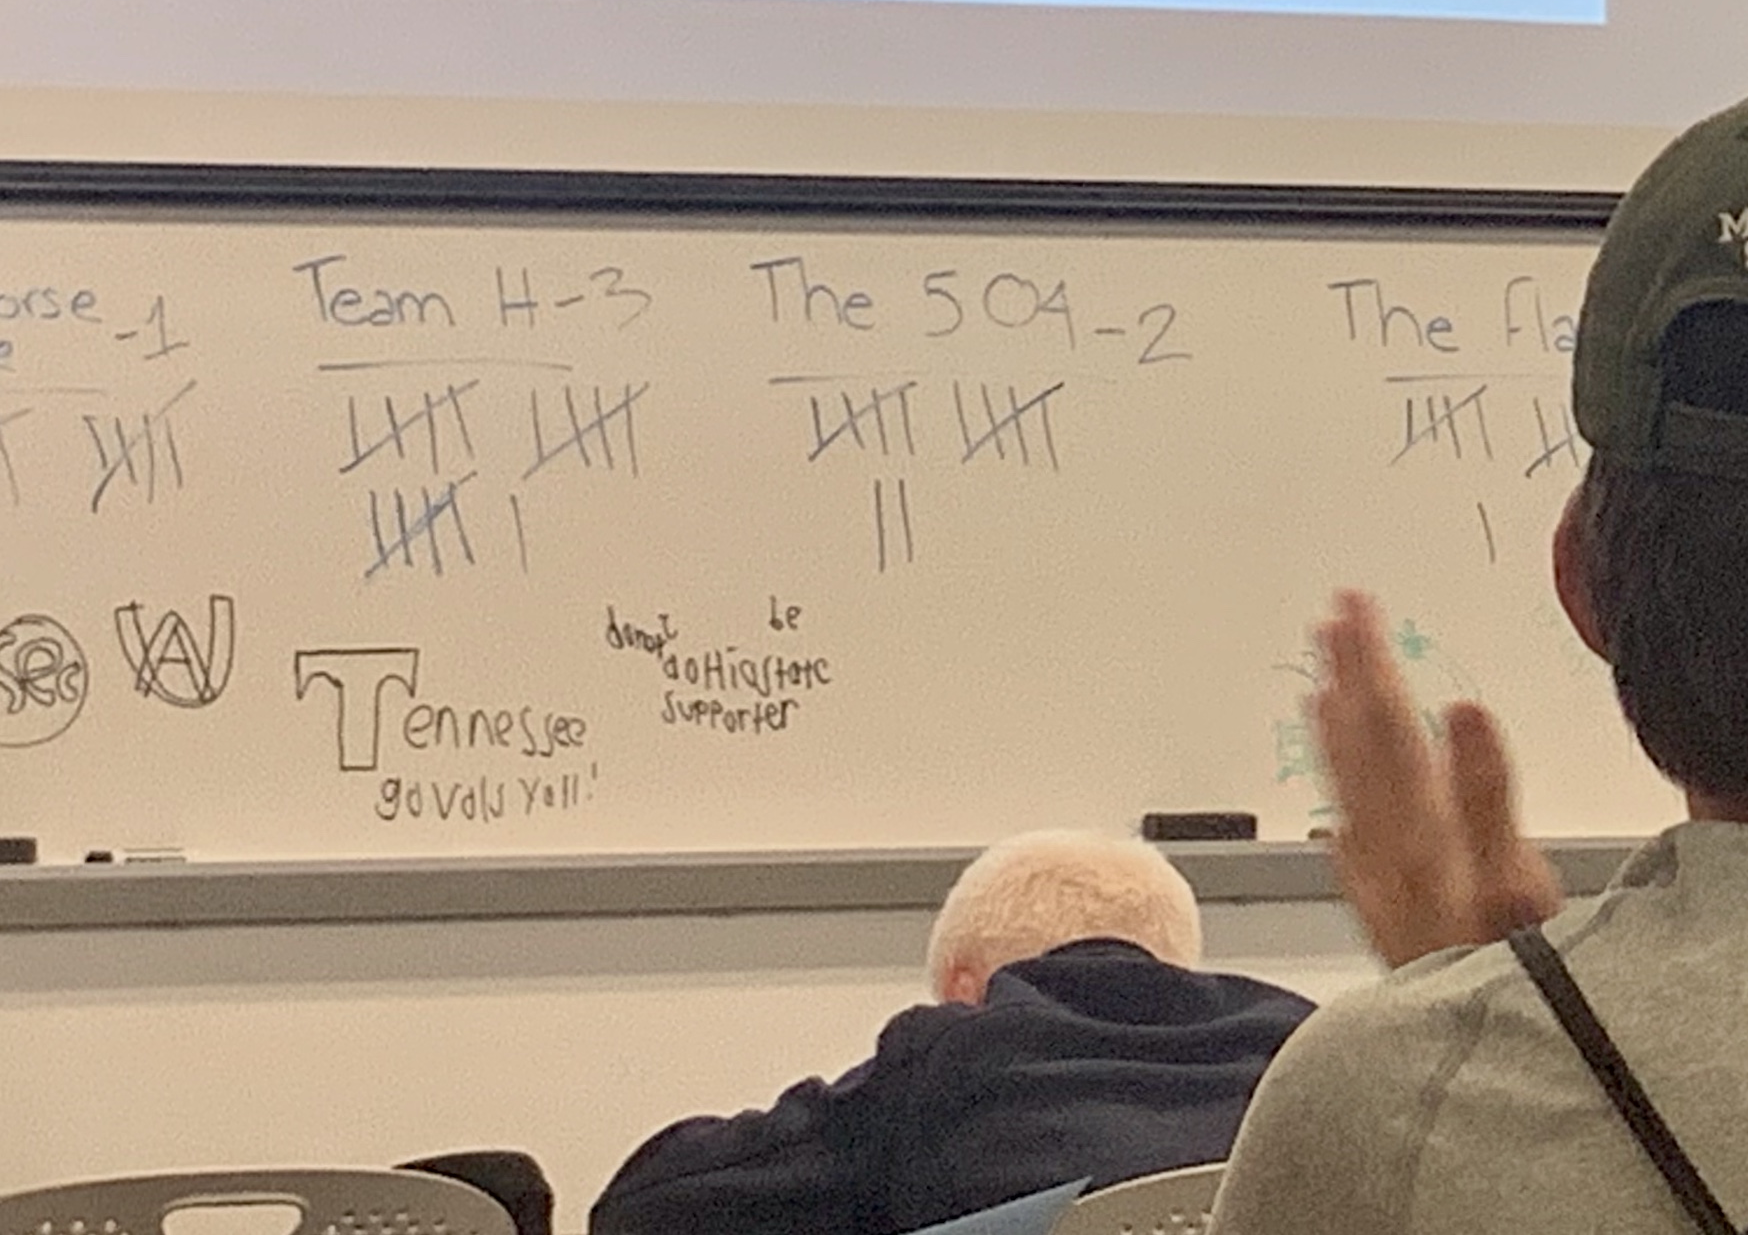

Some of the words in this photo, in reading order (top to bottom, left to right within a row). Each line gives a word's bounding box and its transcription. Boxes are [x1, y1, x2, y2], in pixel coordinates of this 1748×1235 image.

[293, 254, 456, 328] Team
[750, 257, 875, 331] The
[1327, 278, 1460, 353] The
